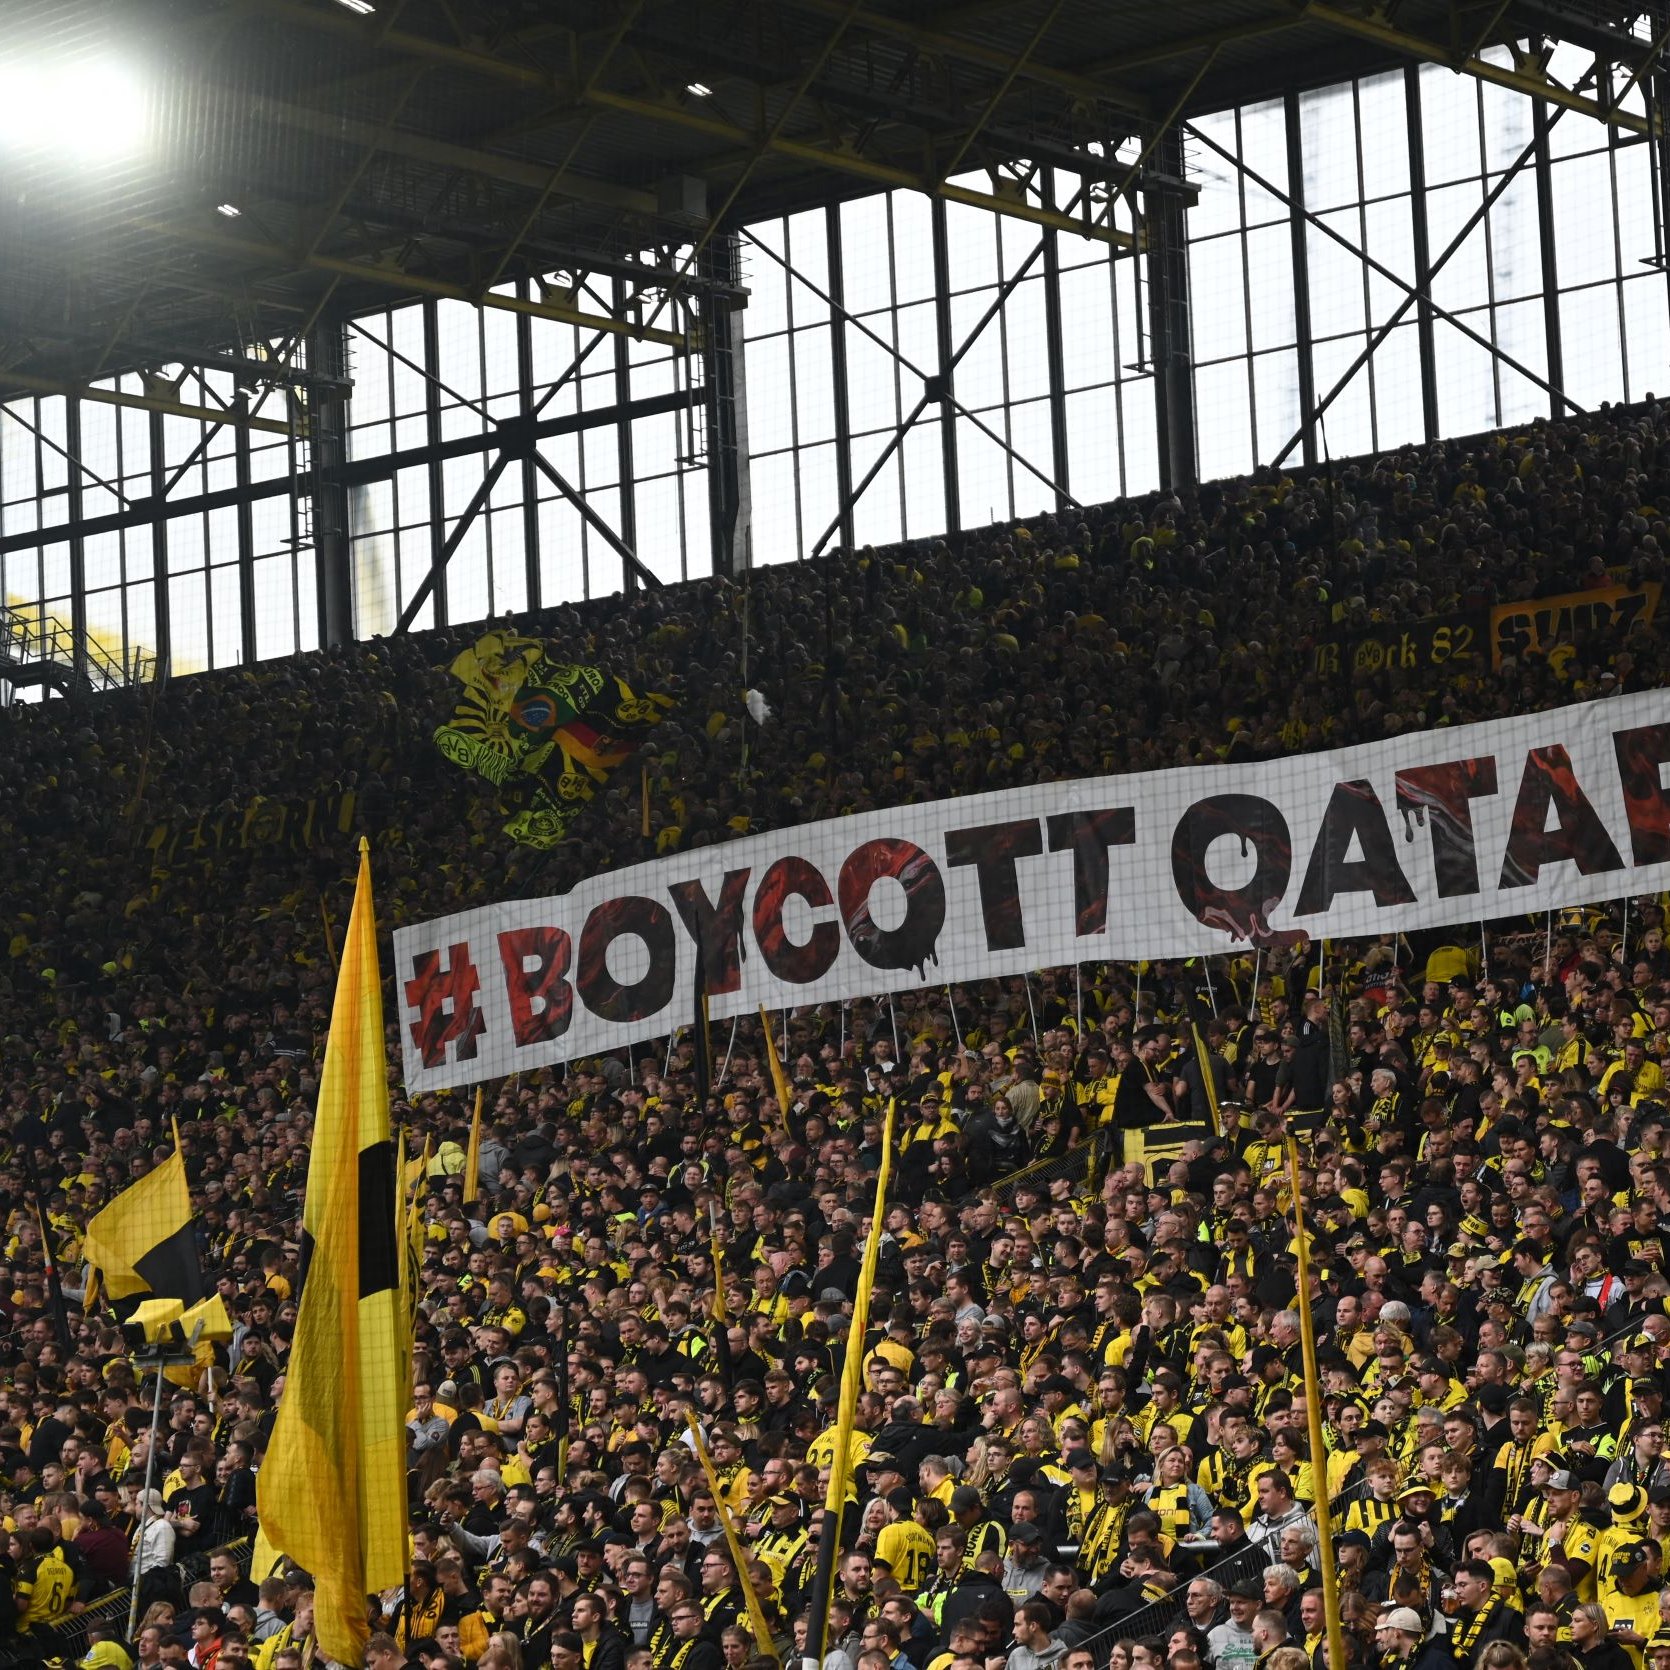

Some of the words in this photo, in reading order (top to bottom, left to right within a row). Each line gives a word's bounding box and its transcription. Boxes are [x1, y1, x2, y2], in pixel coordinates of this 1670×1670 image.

[1430, 622, 1475, 664] 82
[404, 807, 1135, 1069] #BOYCOTT
[49, 1582, 63, 1613] 6
